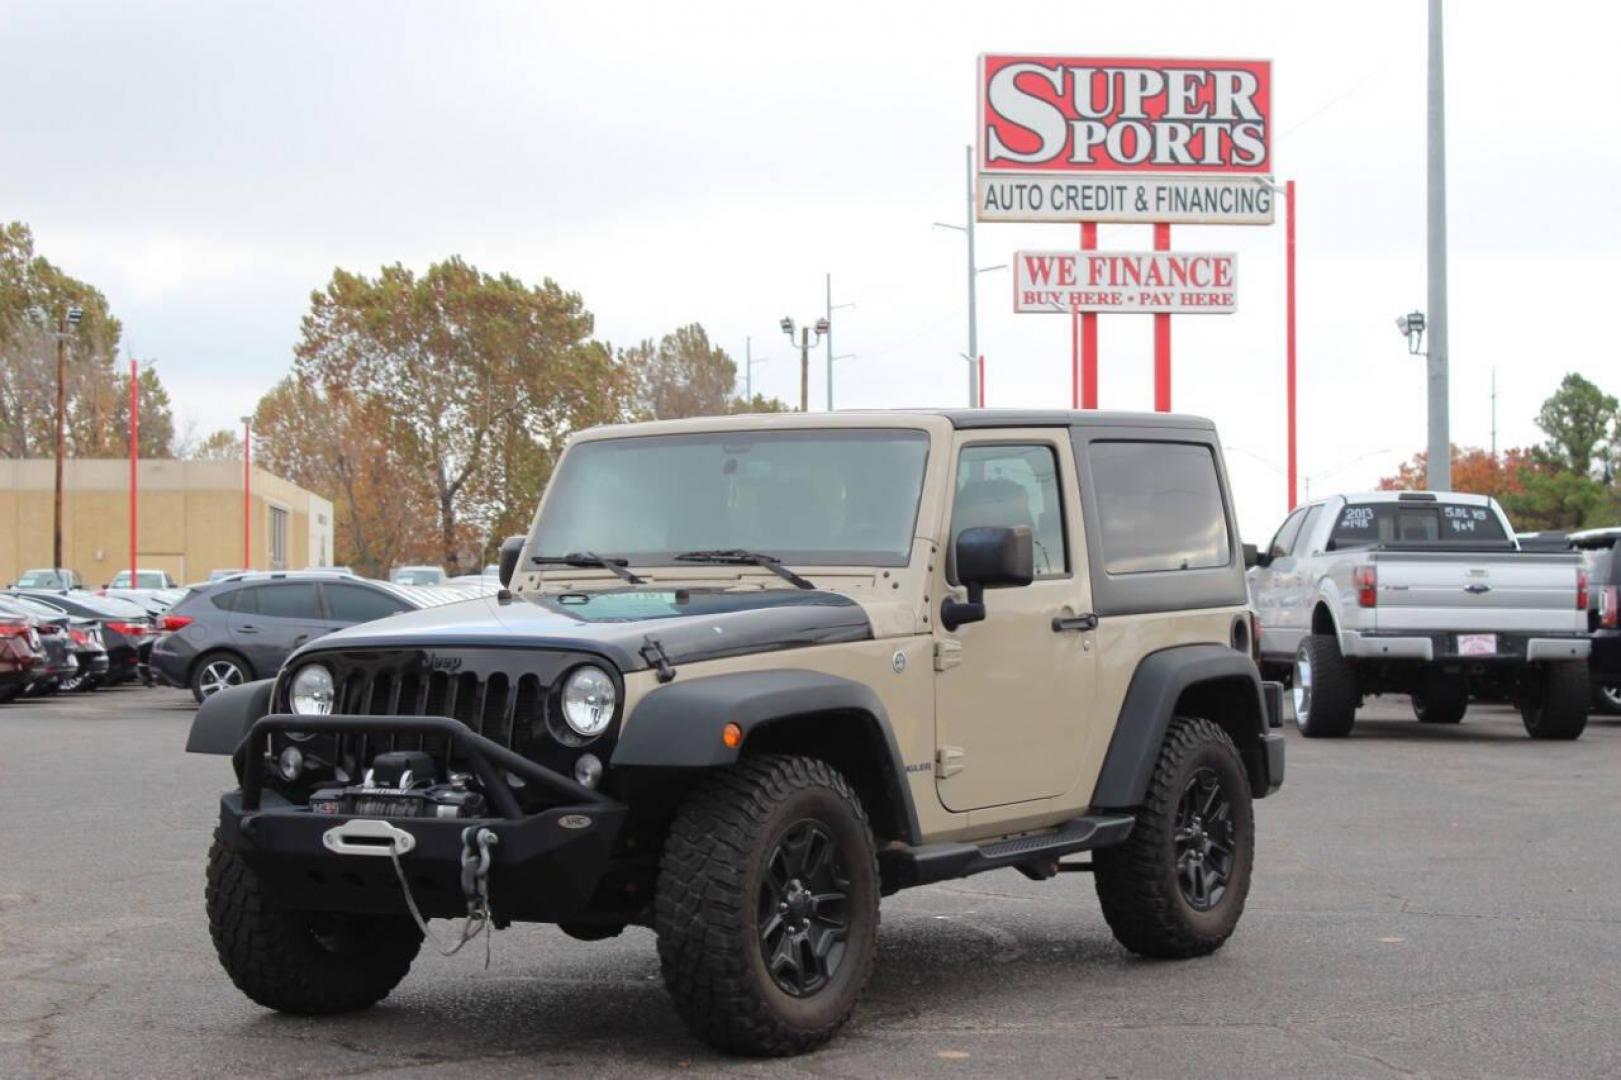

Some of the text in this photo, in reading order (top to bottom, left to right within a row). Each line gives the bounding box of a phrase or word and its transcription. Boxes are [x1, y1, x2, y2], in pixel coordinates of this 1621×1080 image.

[987, 61, 1264, 163] SUPER
[984, 184, 1270, 214] AUTO CREDIT & FINANCING
[1024, 256, 1234, 288] WE FINANCE
[1023, 291, 1234, 307] BUY HERE PAY HERE
[1345, 507, 1374, 520] 2013
